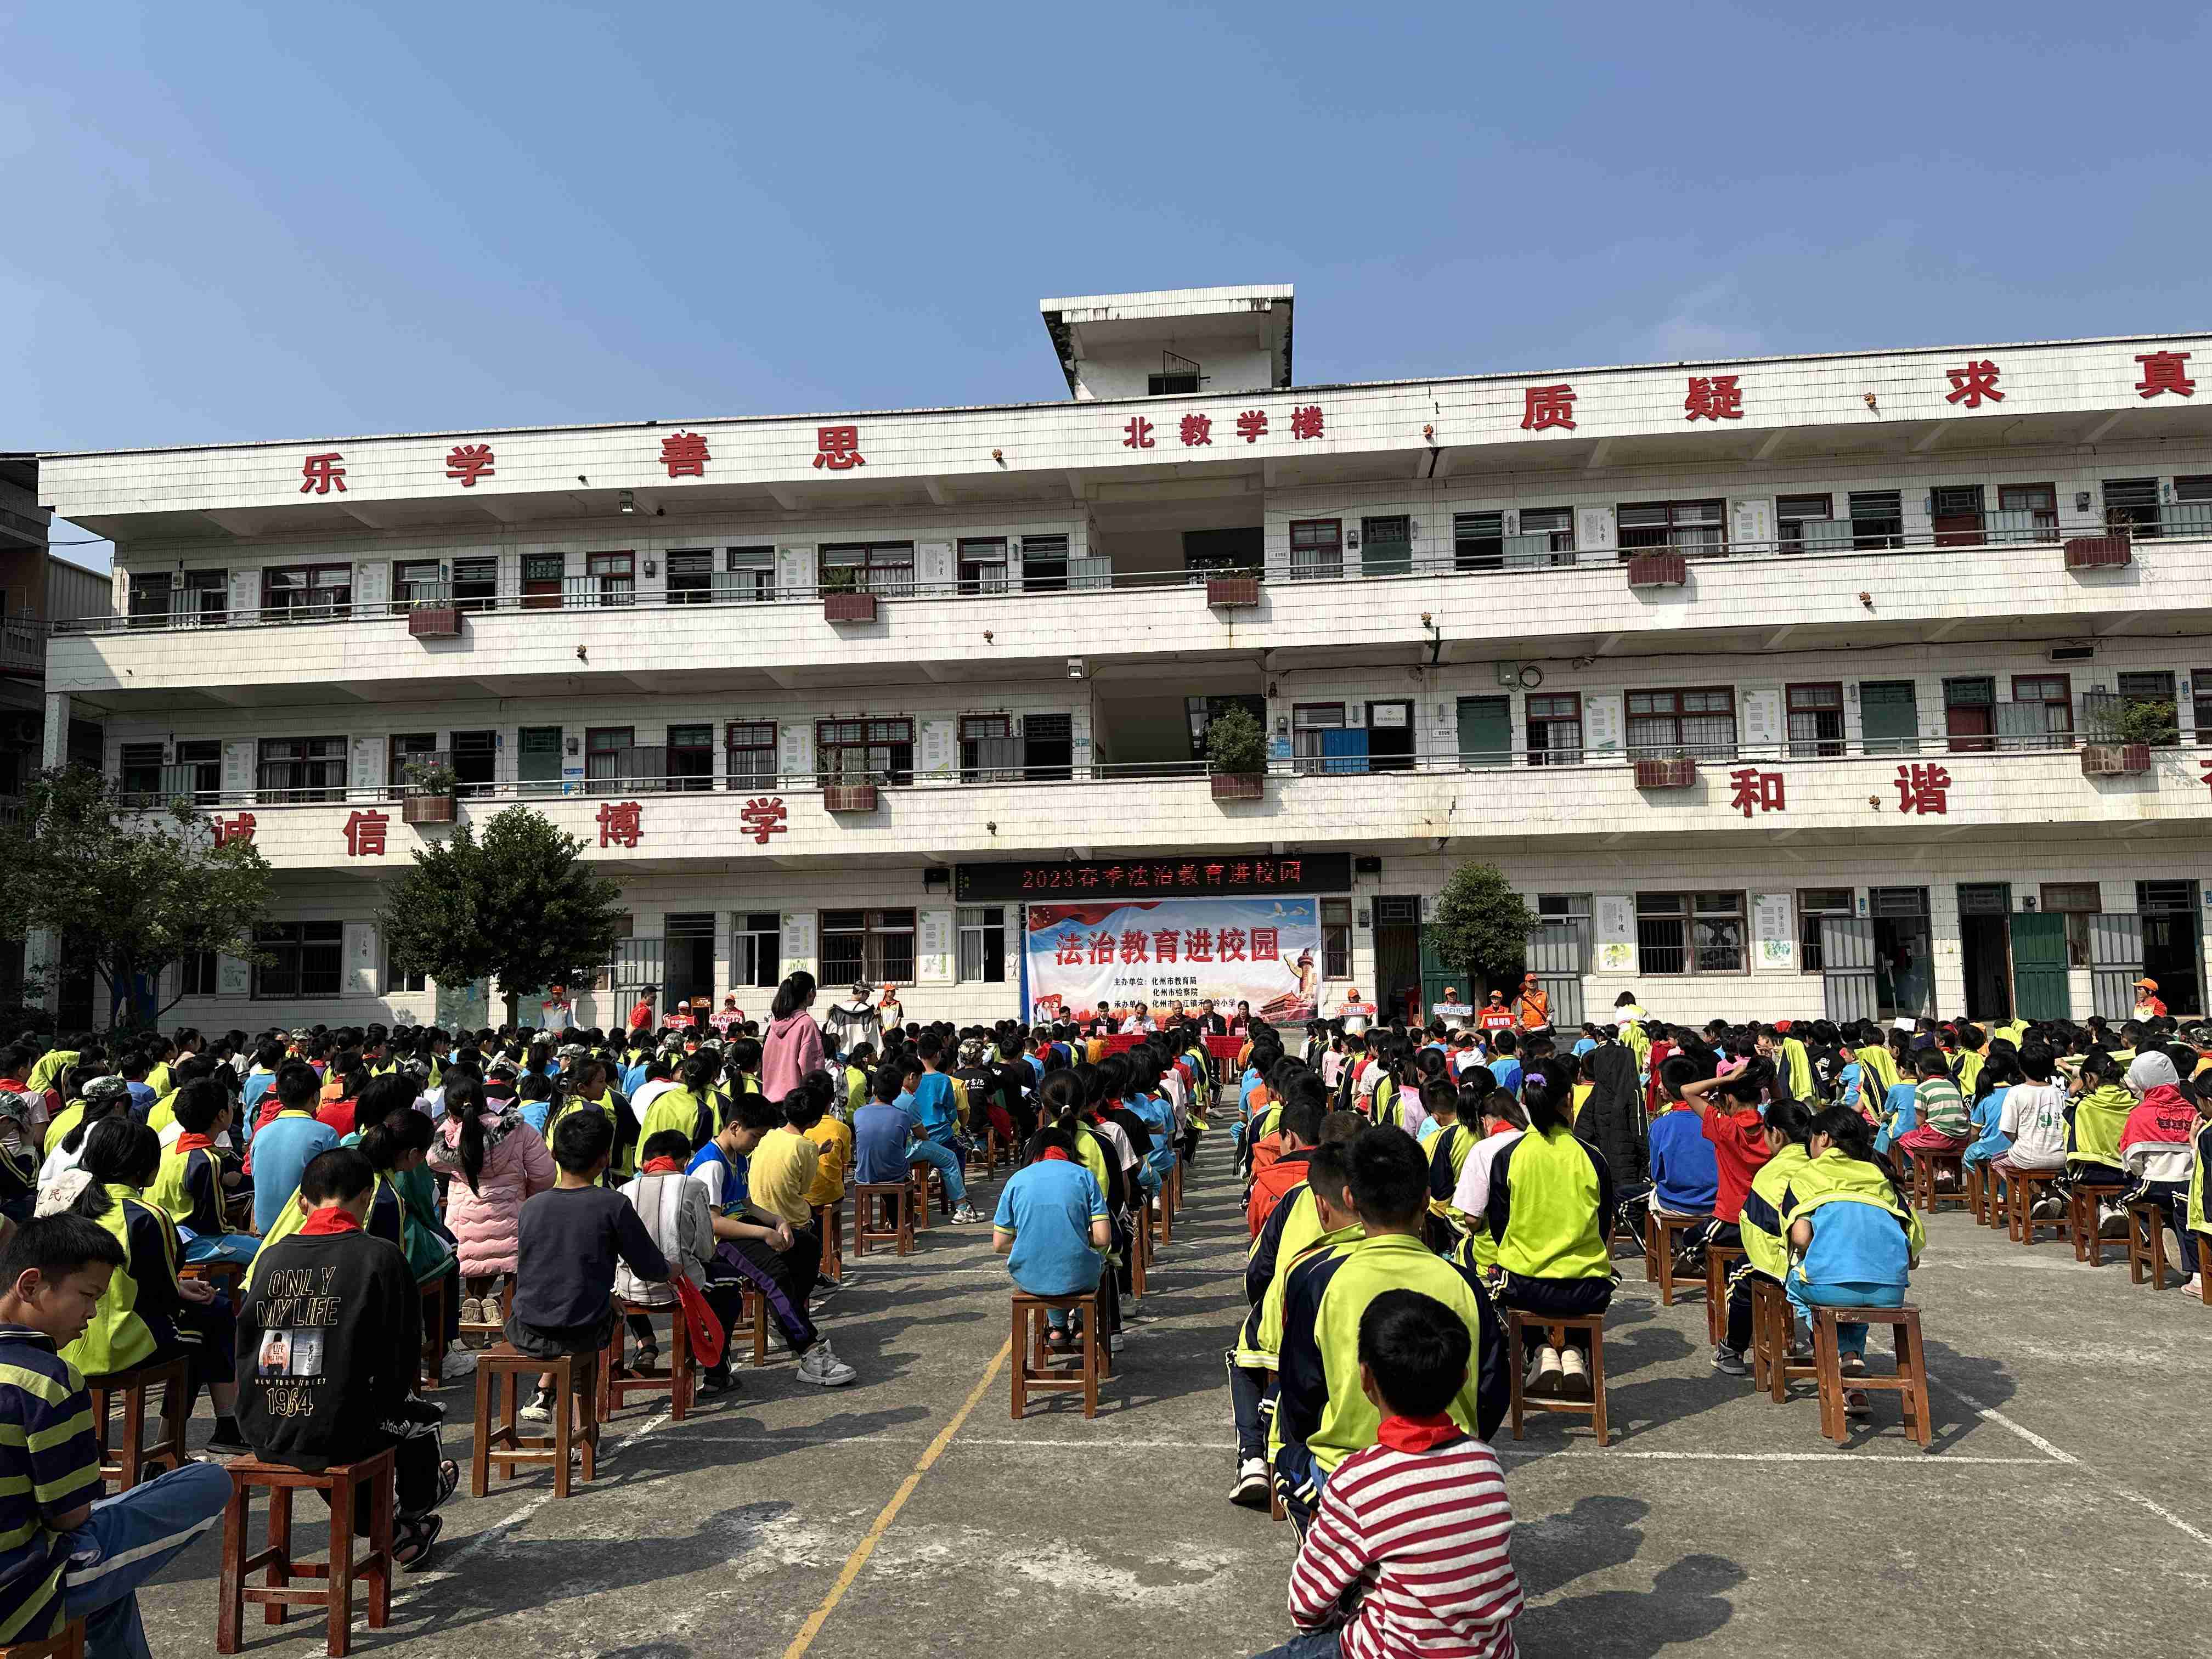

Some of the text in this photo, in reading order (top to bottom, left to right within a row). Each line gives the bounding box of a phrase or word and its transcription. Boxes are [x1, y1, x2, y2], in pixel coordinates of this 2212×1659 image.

[1122, 405, 1325, 449] 北教学楼
[1022, 861, 1302, 888] 2023春季法治教育进校园
[1054, 926, 1281, 966] 法治教育进校园
[1152, 976, 1197, 986] 化州市教育局
[1153, 987, 1199, 996] 化州市检察院
[1152, 998, 1235, 1008] 化州市江镇禾岭小学
[268, 1266, 336, 1297] ONLY
